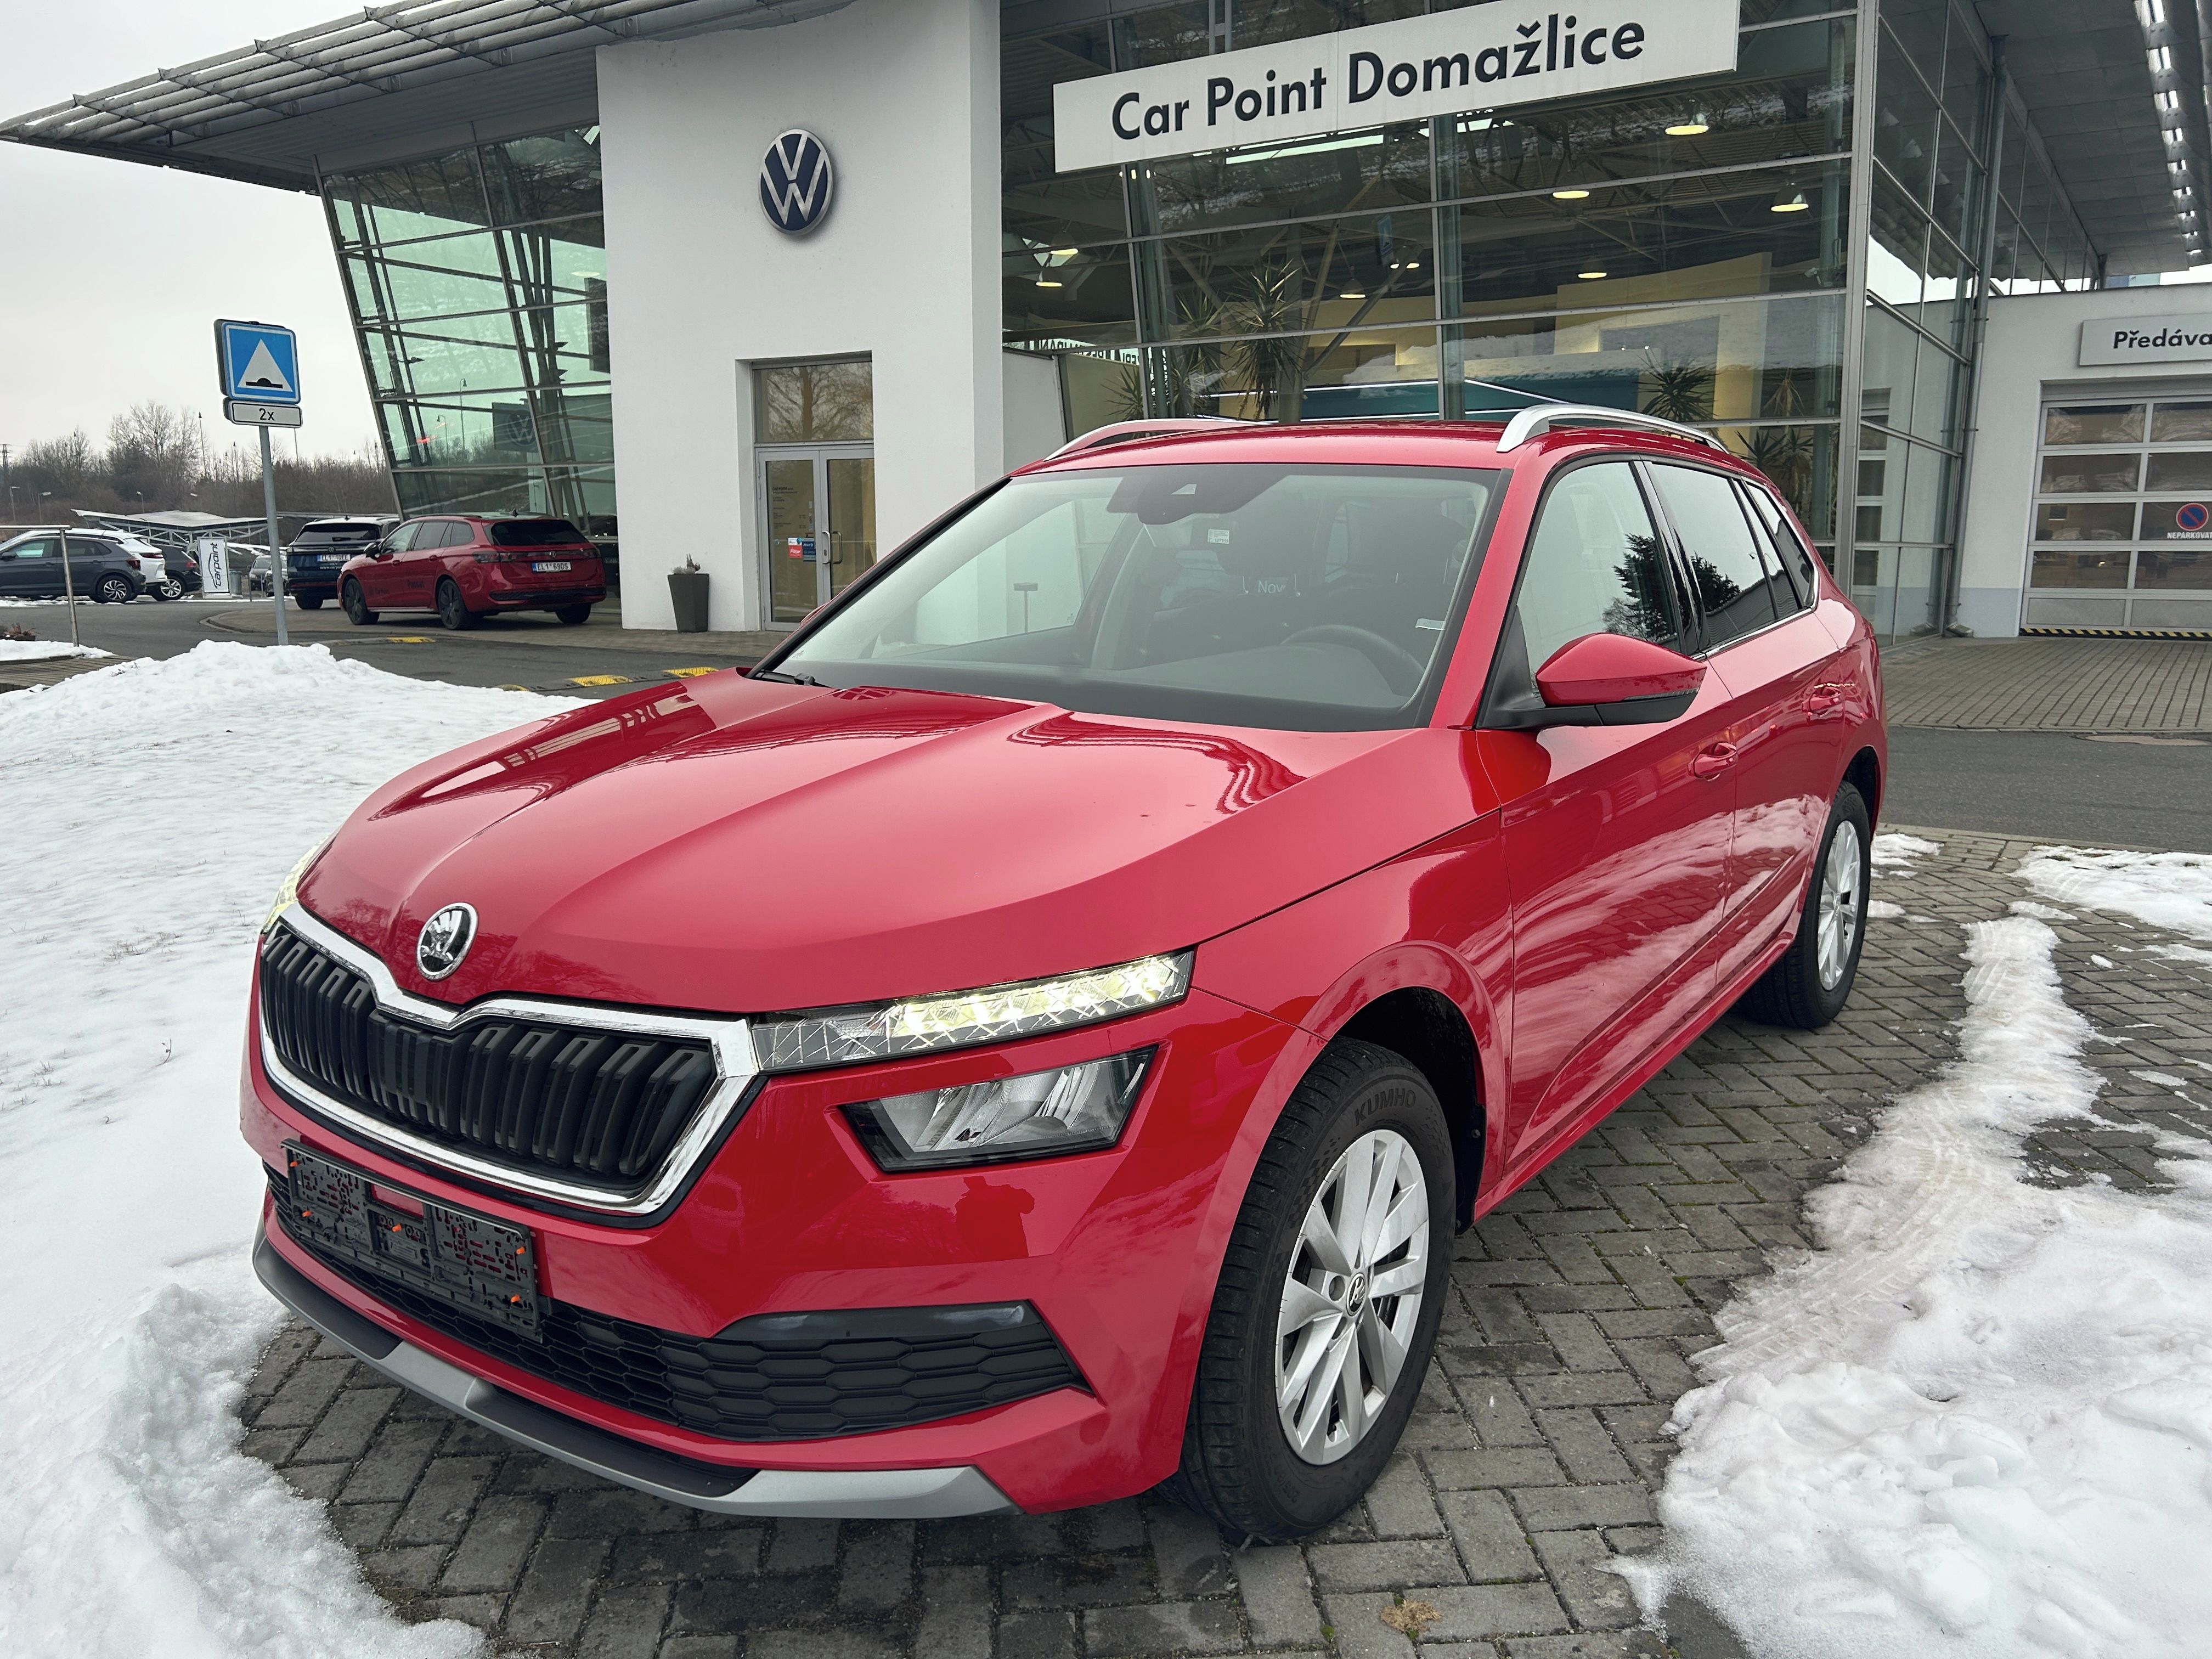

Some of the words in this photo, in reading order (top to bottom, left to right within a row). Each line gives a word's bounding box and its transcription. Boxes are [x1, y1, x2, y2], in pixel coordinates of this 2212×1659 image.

[1112, 92, 1189, 140] Car
[1207, 69, 1327, 126] Point
[1348, 13, 1645, 104] Domažlice
[2113, 328, 2212, 349] Předáva
[258, 408, 275, 421] 2x
[210, 542, 222, 587] carpoint
[537, 562, 549, 571] EL1
[1354, 1087, 1416, 1127] KUMHO
